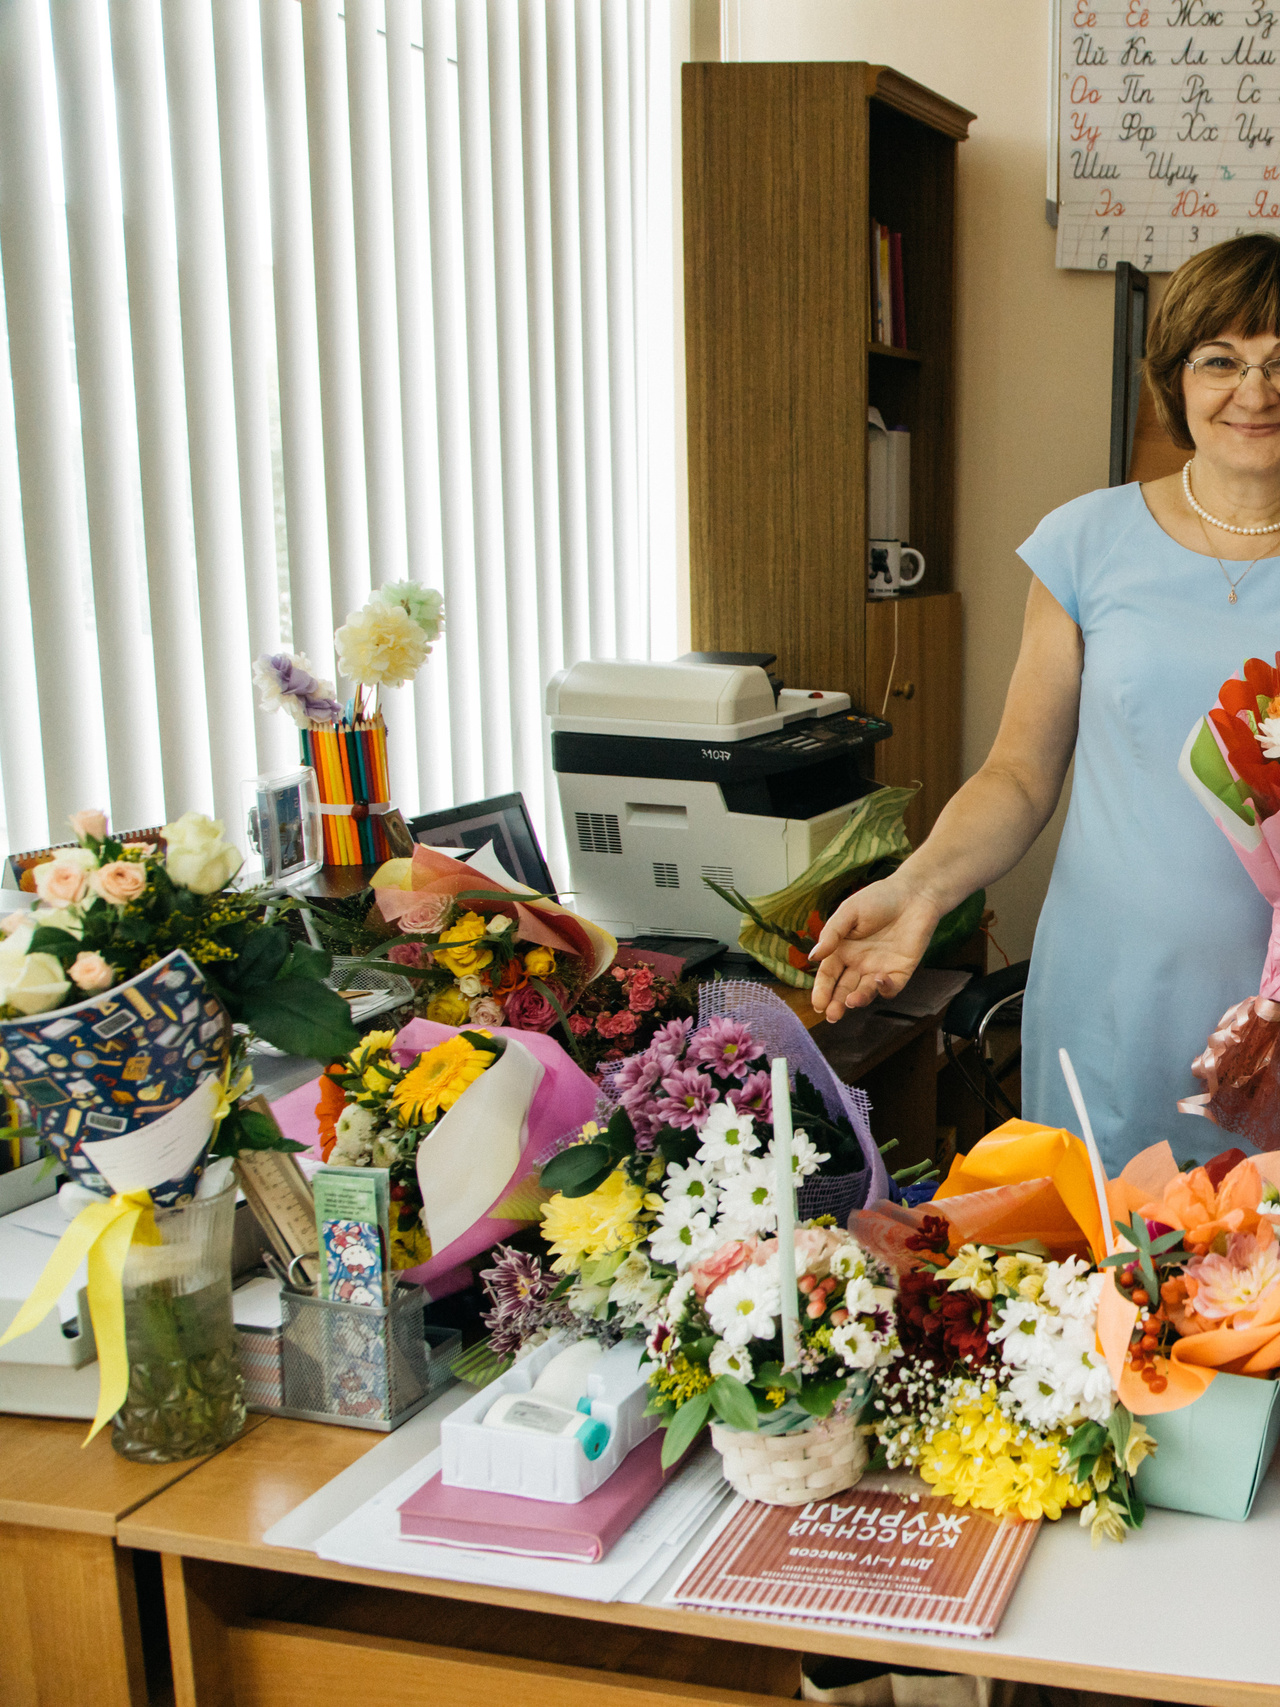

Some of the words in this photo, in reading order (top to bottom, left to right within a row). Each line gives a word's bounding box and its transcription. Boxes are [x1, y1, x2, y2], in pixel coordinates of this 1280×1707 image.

[1167, 0, 1224, 27] Жж
[1245, 0, 1277, 38] Зз
[1073, 33, 1108, 66] Йй
[1120, 36, 1156, 66] Кк
[1171, 37, 1208, 66] Лл
[1221, 37, 1276, 66] Мм
[1070, 75, 1102, 104] Оо
[1117, 74, 1155, 104] Пп
[1181, 74, 1213, 113] Рр
[1236, 74, 1261, 104] Сс
[1070, 112, 1102, 151] Уу
[1118, 112, 1157, 151] Фф
[1177, 112, 1219, 142] Хх
[1235, 113, 1275, 149] Цц
[1070, 151, 1121, 179] Шш
[1145, 151, 1199, 186] Щщ
[1095, 189, 1126, 217] Ээ
[1171, 189, 1219, 218] Юю
[1100, 226, 1109, 241] 1
[1145, 226, 1154, 242] 2
[1188, 226, 1199, 242] 3
[1097, 253, 1108, 269] 6
[798, 1502, 971, 1533] ЖУРНАЛ
[787, 1520, 960, 1549] КЛАССНЫЙ
[788, 1547, 857, 1563] классов
[900, 1556, 934, 1571] Для
